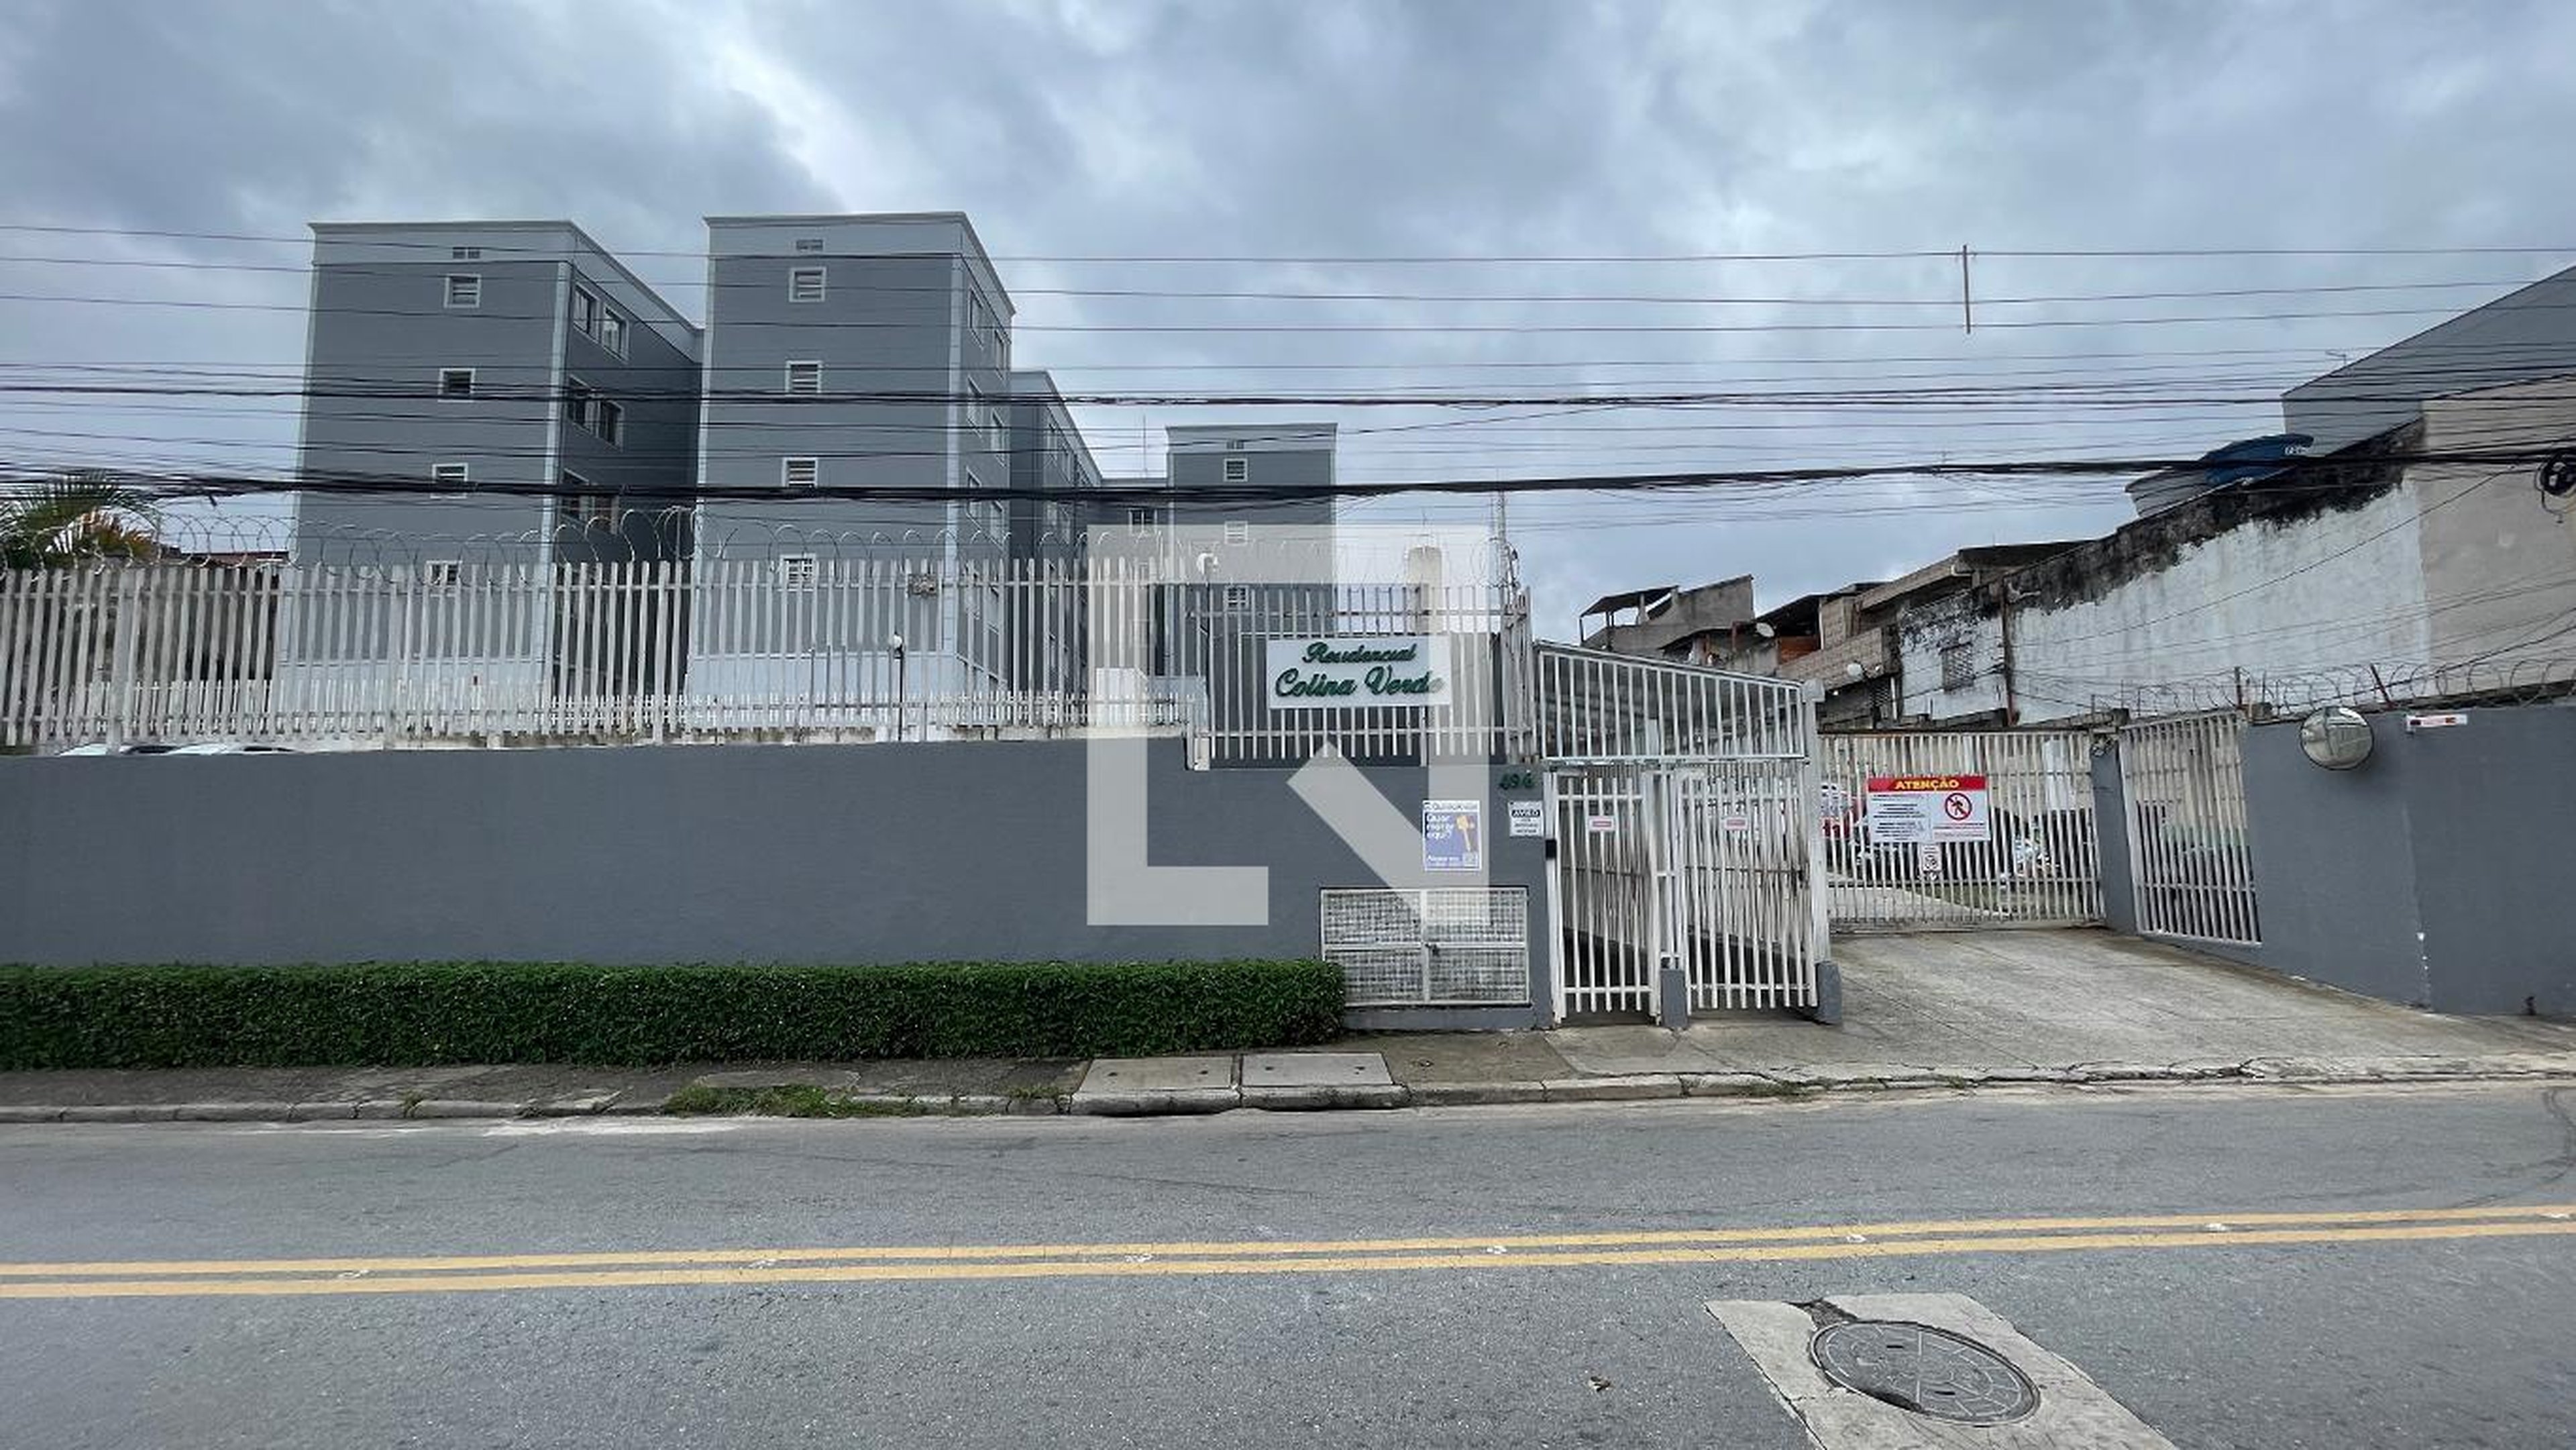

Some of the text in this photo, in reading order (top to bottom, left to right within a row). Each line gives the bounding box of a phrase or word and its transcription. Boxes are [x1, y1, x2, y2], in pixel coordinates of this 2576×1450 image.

[1302, 641, 1417, 664] Residencial
[1275, 664, 1444, 698] Colina Verde
[1894, 778, 1960, 792] ATENÇÃO
